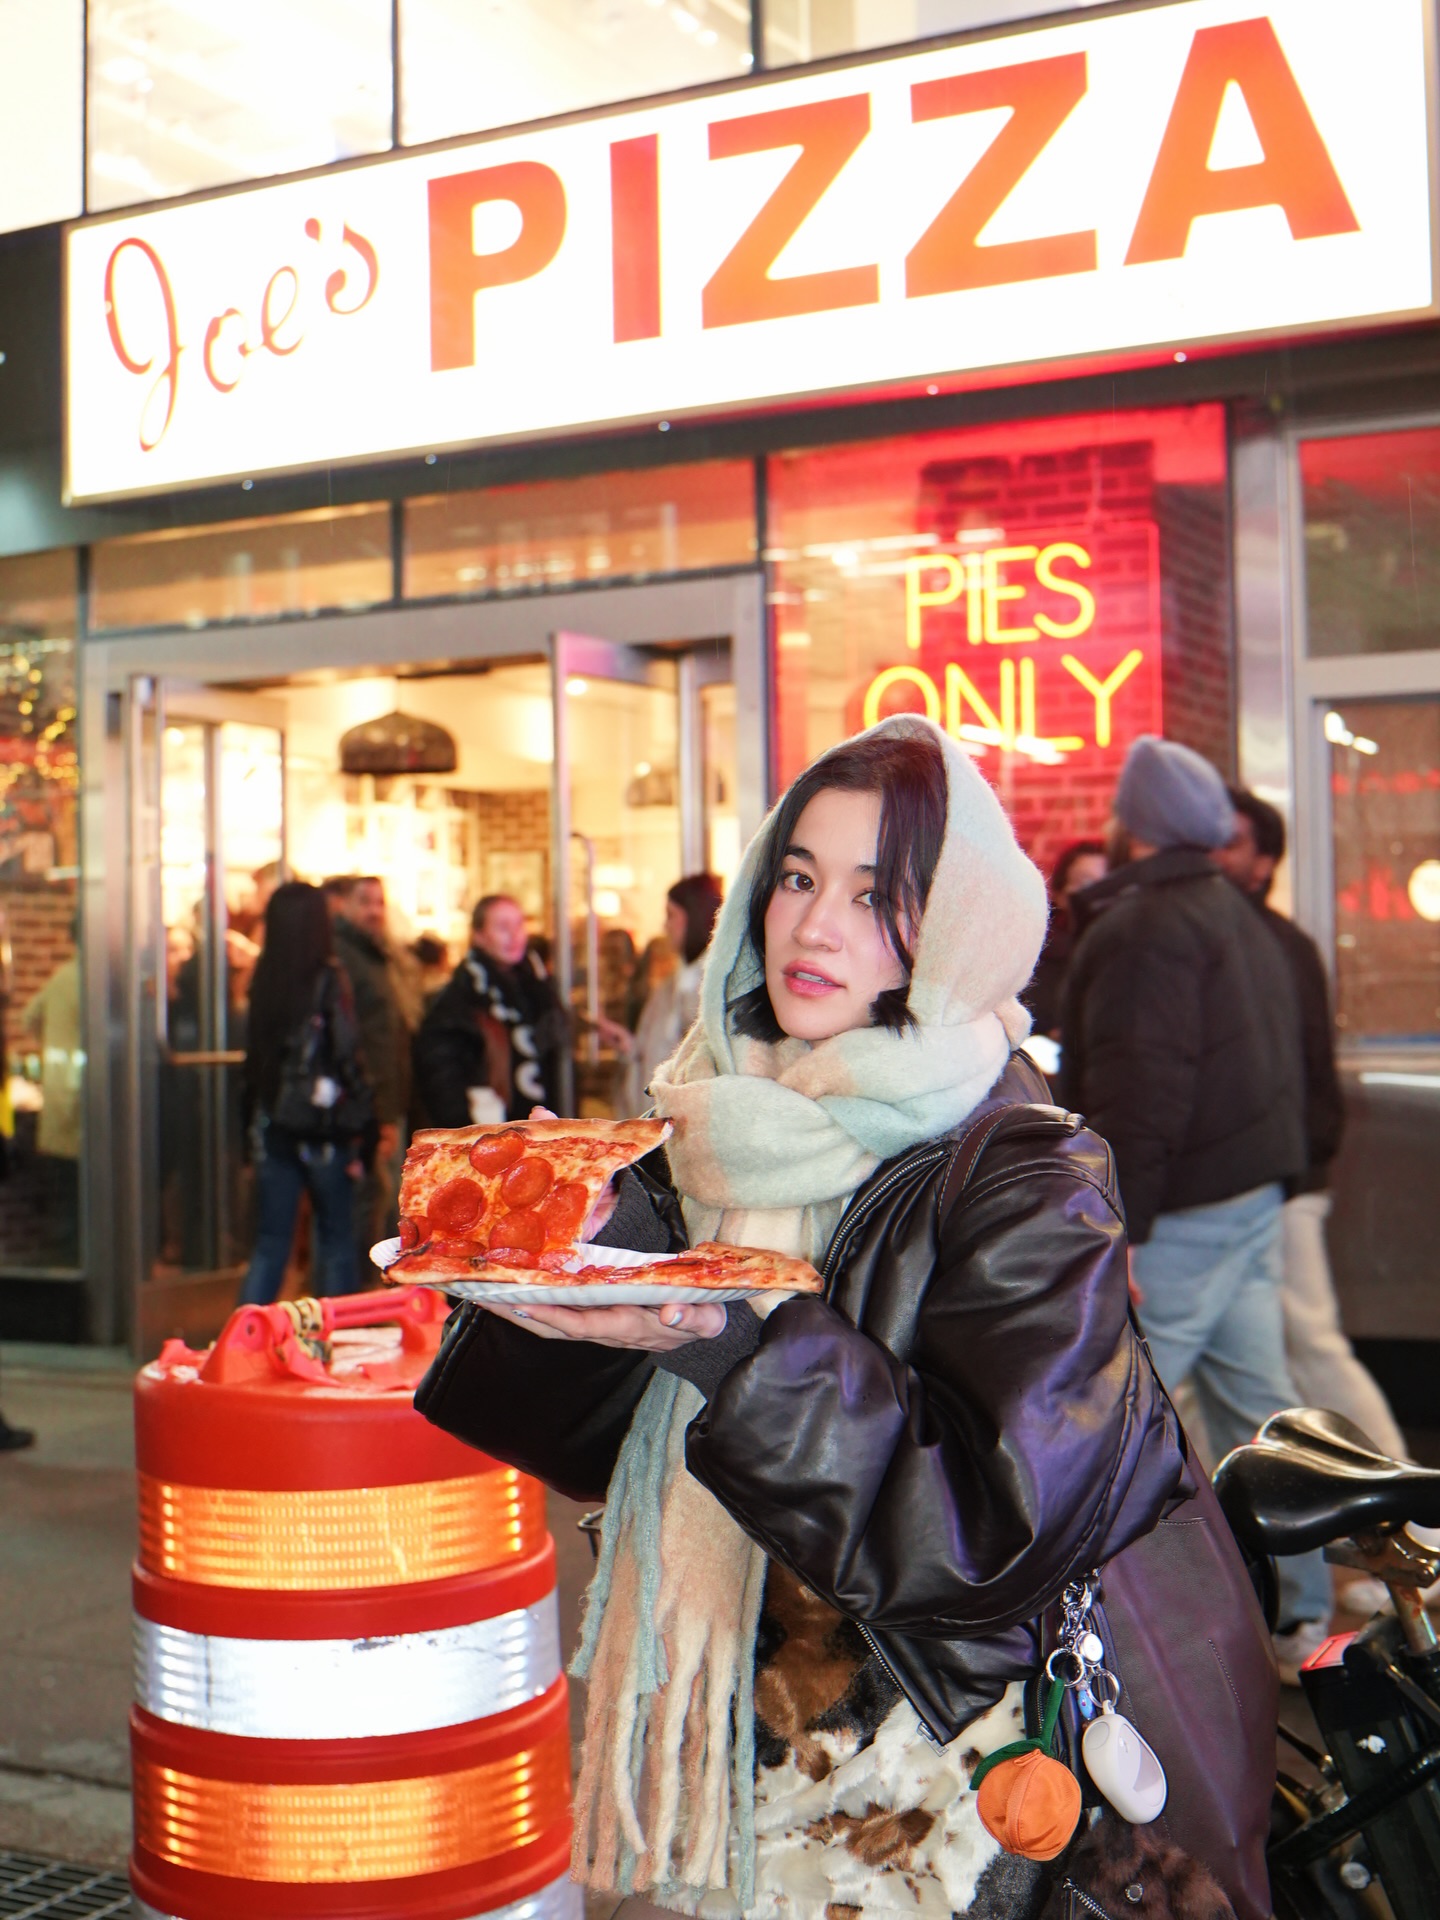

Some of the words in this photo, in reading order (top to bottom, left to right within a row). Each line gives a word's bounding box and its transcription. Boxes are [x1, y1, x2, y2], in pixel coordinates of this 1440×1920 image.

[103, 217, 380, 453] Joe's
[427, 16, 1362, 373] PIZZA
[905, 542, 1096, 650] PIES
[863, 649, 1143, 754] ONLY
